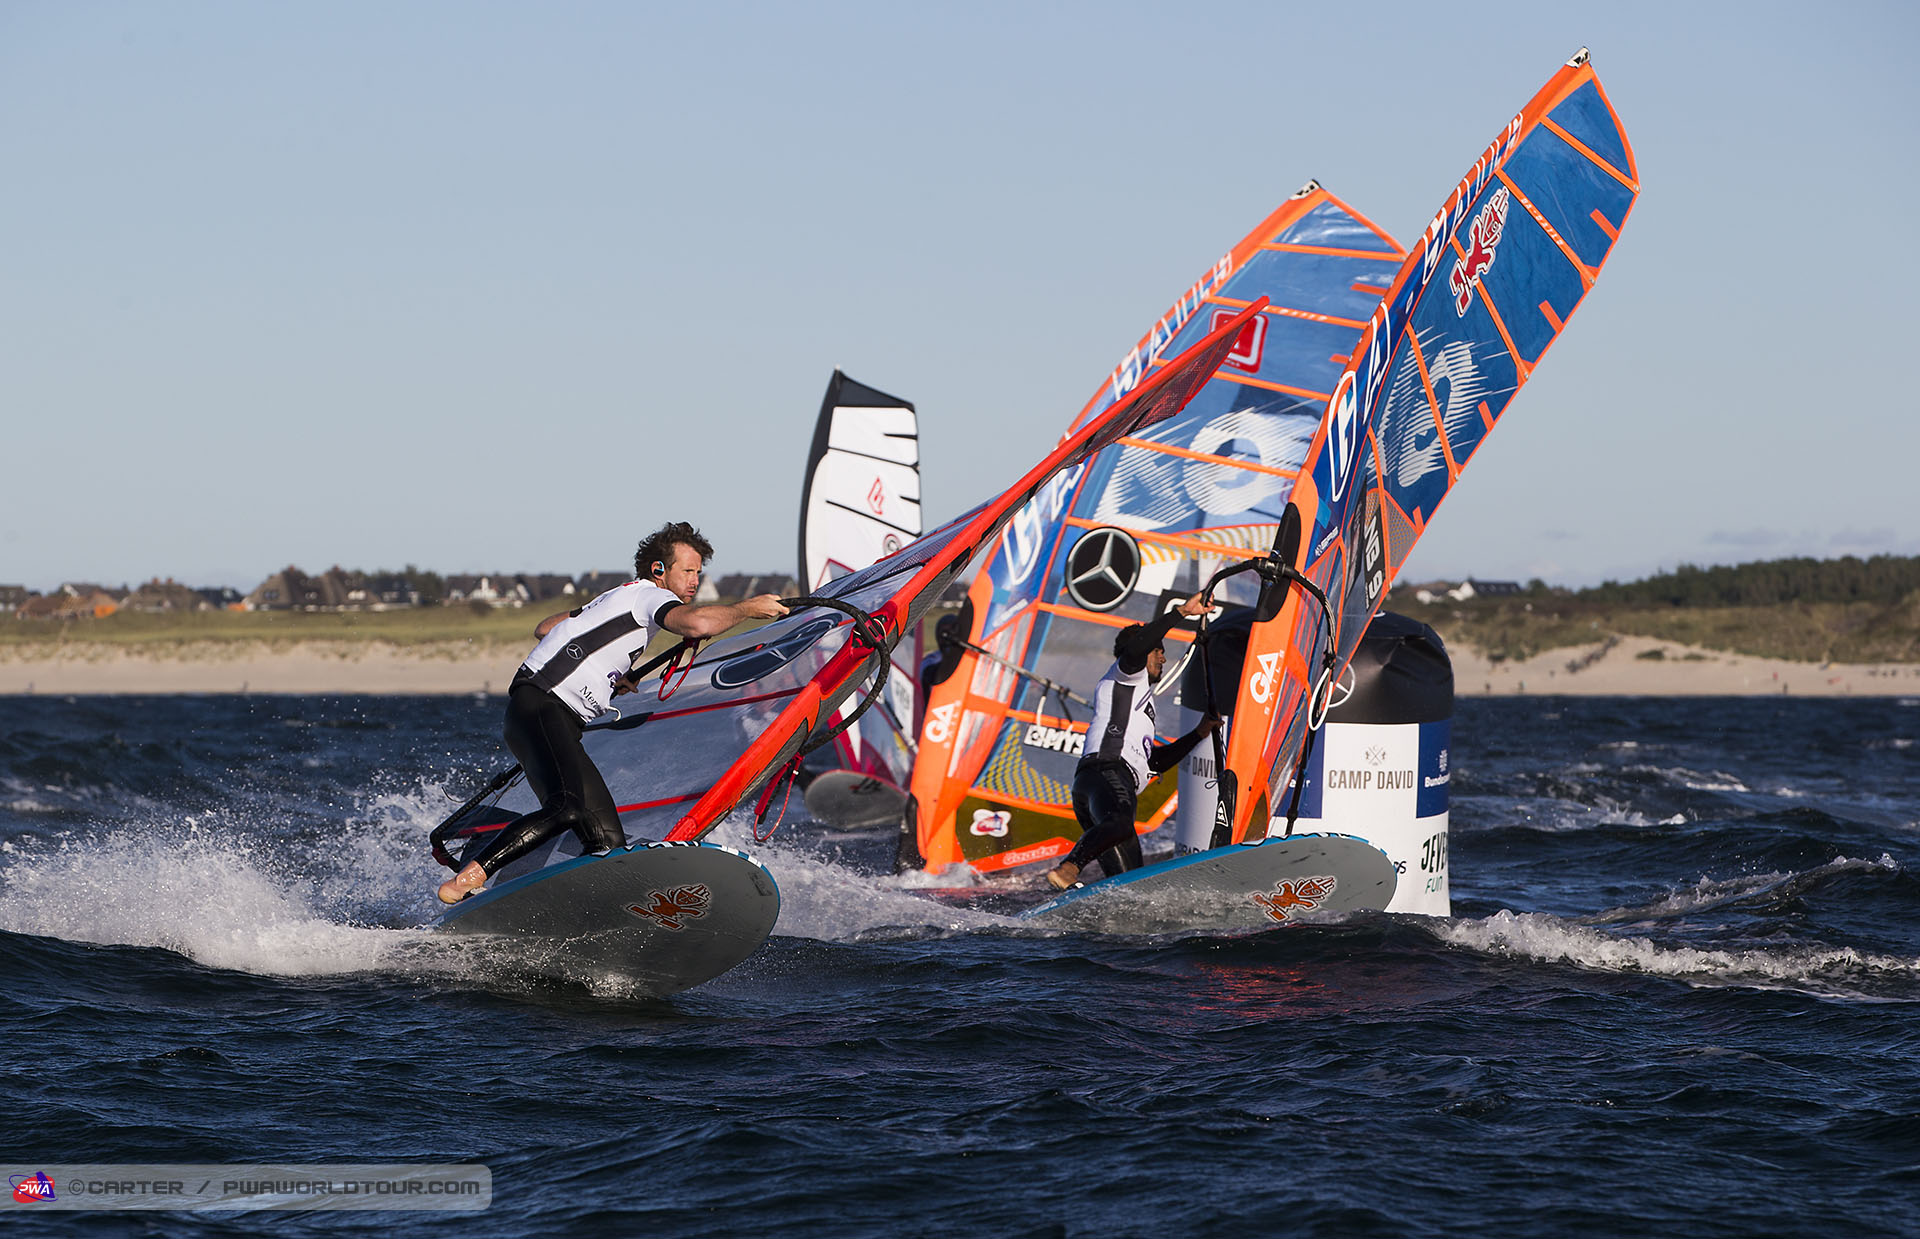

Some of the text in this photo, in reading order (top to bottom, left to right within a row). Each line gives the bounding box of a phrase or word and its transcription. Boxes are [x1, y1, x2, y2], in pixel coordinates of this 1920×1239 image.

[1250, 652, 1279, 704] GA
[925, 703, 955, 743] GA
[1328, 769, 1372, 790] CAMP
[1377, 770, 1414, 790] DAVID
